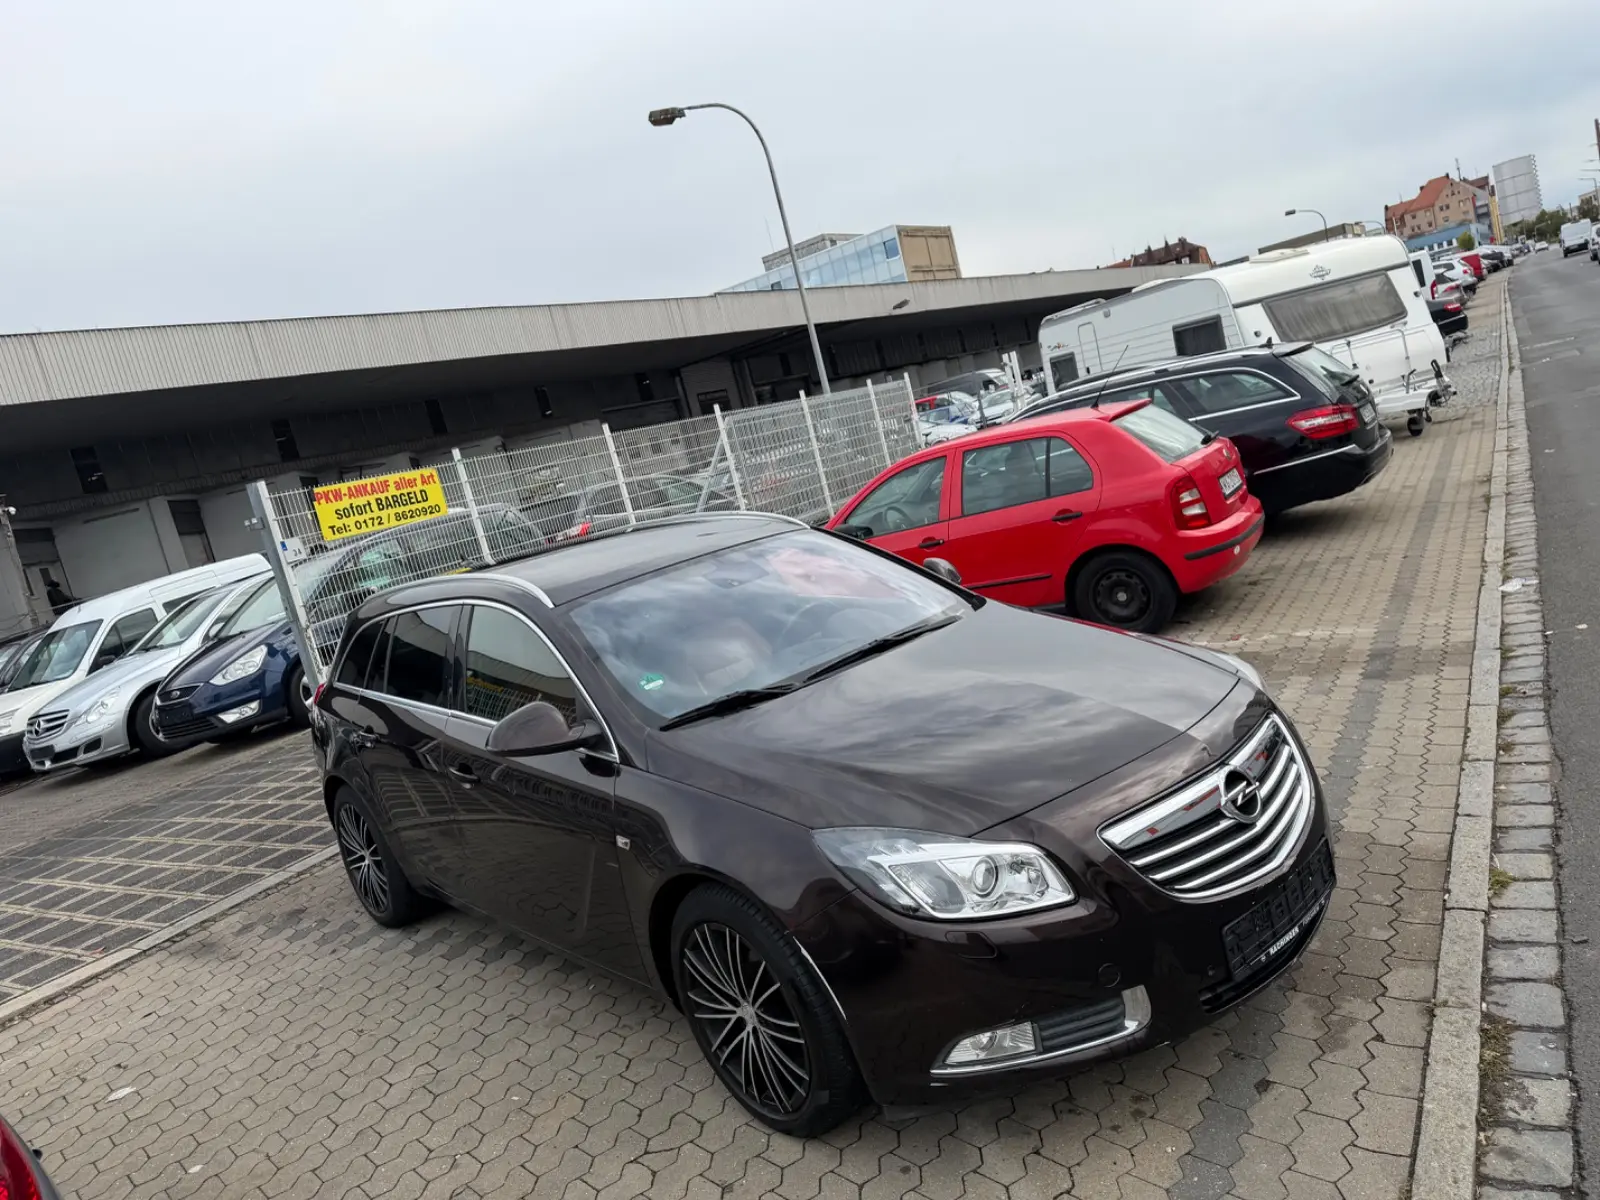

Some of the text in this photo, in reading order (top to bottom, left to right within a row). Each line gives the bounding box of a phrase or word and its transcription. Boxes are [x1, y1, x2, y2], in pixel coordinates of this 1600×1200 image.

[314, 472, 437, 505] PKW-ANKAUF aller Art
[335, 489, 429, 520] sofort BARGELD
[328, 524, 352, 536] Tel:
[354, 516, 384, 531] 0172
[395, 504, 441, 522] 8620920
